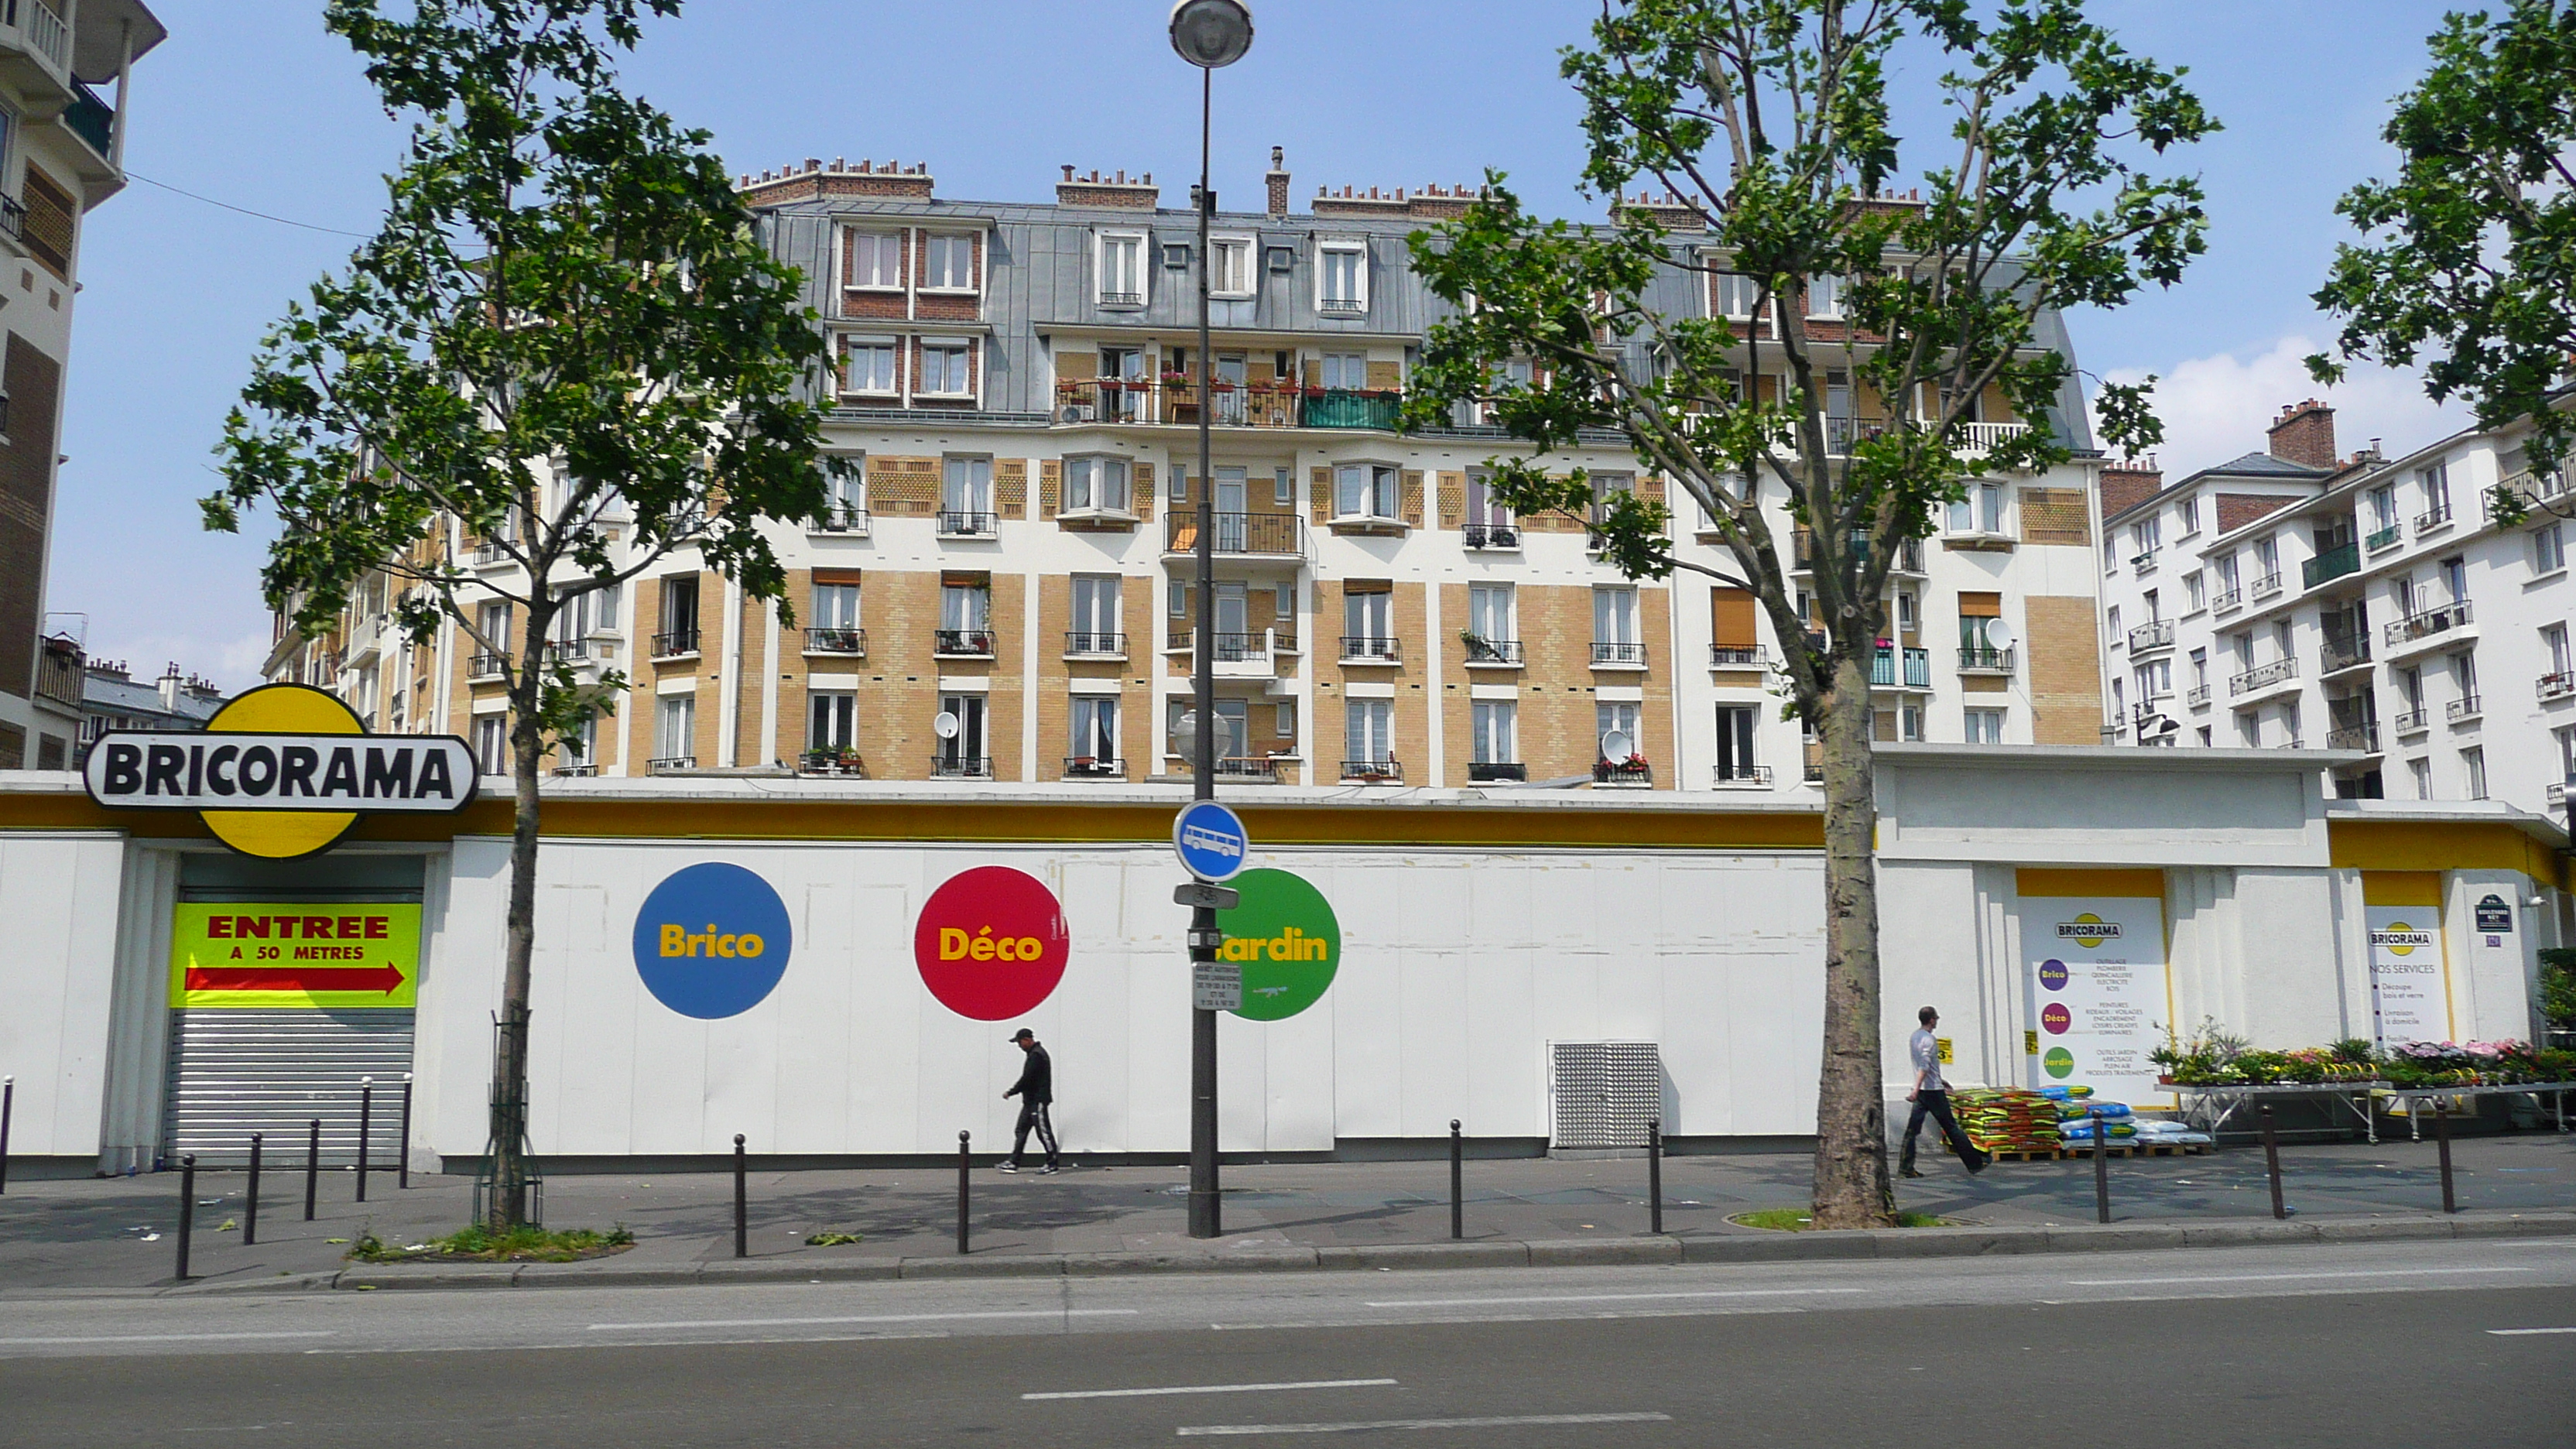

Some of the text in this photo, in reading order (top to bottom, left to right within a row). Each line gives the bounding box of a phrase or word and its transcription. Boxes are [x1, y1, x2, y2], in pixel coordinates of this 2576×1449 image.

[104, 744, 454, 799] BRICORAMA
[207, 916, 389, 939] ENTREE
[2059, 926, 2119, 936] BRICORAMA
[659, 923, 764, 958] Brico
[939, 925, 1043, 961] Déco
[1214, 927, 1327, 961] ardin
[2371, 934, 2430, 944] BRICORAMA
[230, 947, 363, 960] A 50 METRES
[2042, 970, 2065, 978] Brico
[2369, 964, 2435, 974] NOS SERVICES
[2045, 1013, 2067, 1022] Déco
[2044, 1058, 2074, 1067] Jardin
